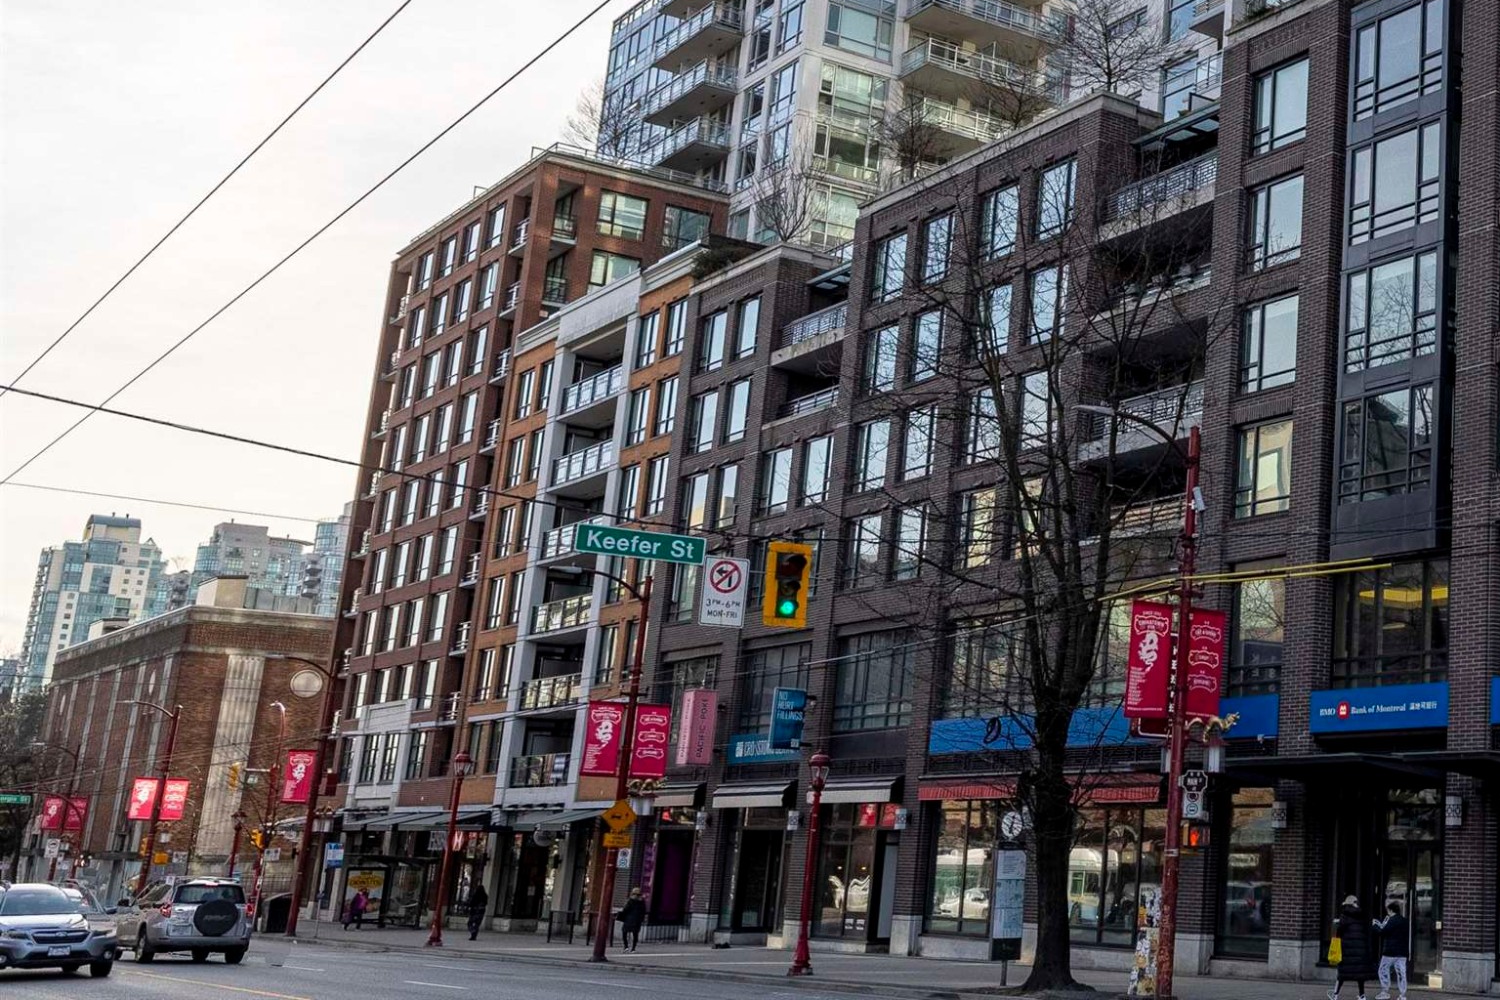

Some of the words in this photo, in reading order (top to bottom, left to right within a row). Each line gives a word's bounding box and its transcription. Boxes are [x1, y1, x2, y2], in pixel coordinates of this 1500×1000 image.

[586, 530, 661, 555] Keefer
[670, 539, 695, 559] St
[706, 609, 738, 619] MON-FRI
[1319, 708, 1336, 716] BMO
[1350, 706, 1368, 715] Bank
[1367, 704, 1376, 713] of
[1376, 703, 1407, 713] Montreal
